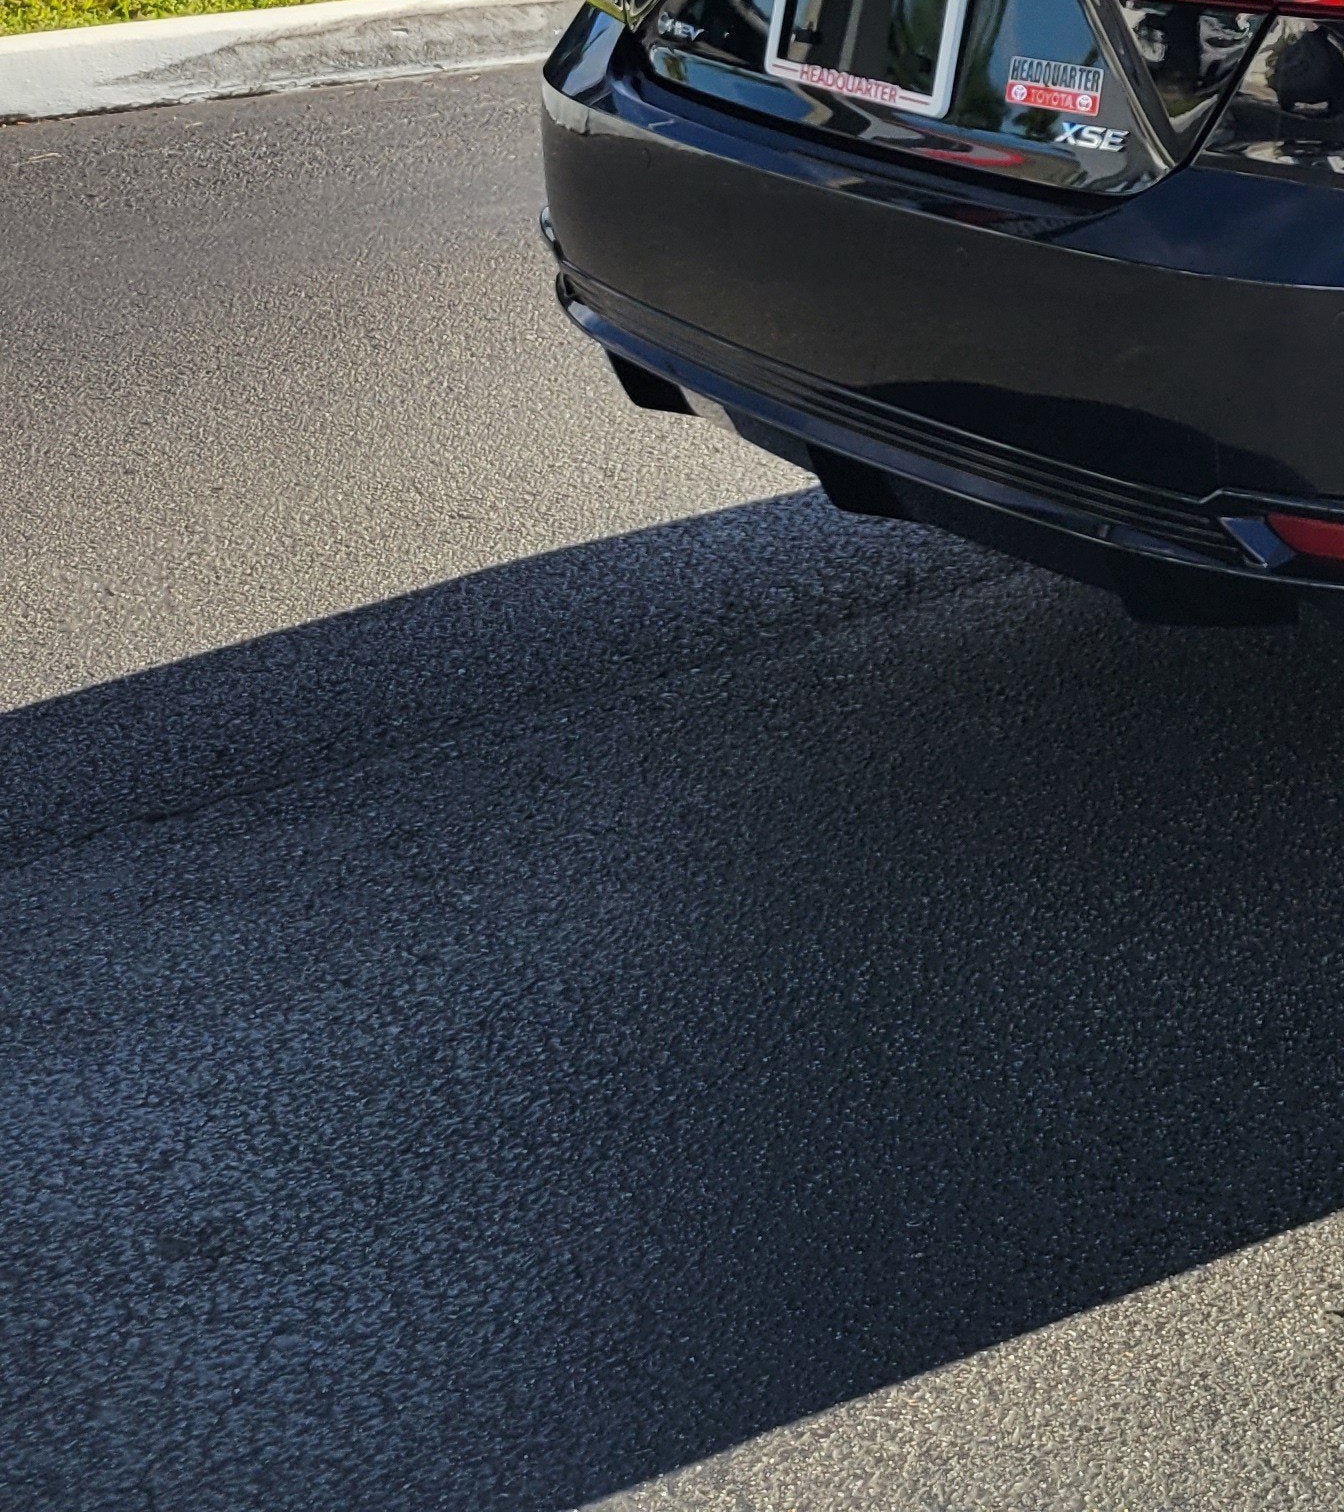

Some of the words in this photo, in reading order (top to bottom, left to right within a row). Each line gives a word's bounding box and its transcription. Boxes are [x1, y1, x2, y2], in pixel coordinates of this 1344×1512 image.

[800, 63, 898, 104] HEADQUARTER
[1010, 58, 1101, 93] HEADQUARTER
[1029, 89, 1076, 109] TOYOTA
[1053, 121, 1131, 153] XSE
